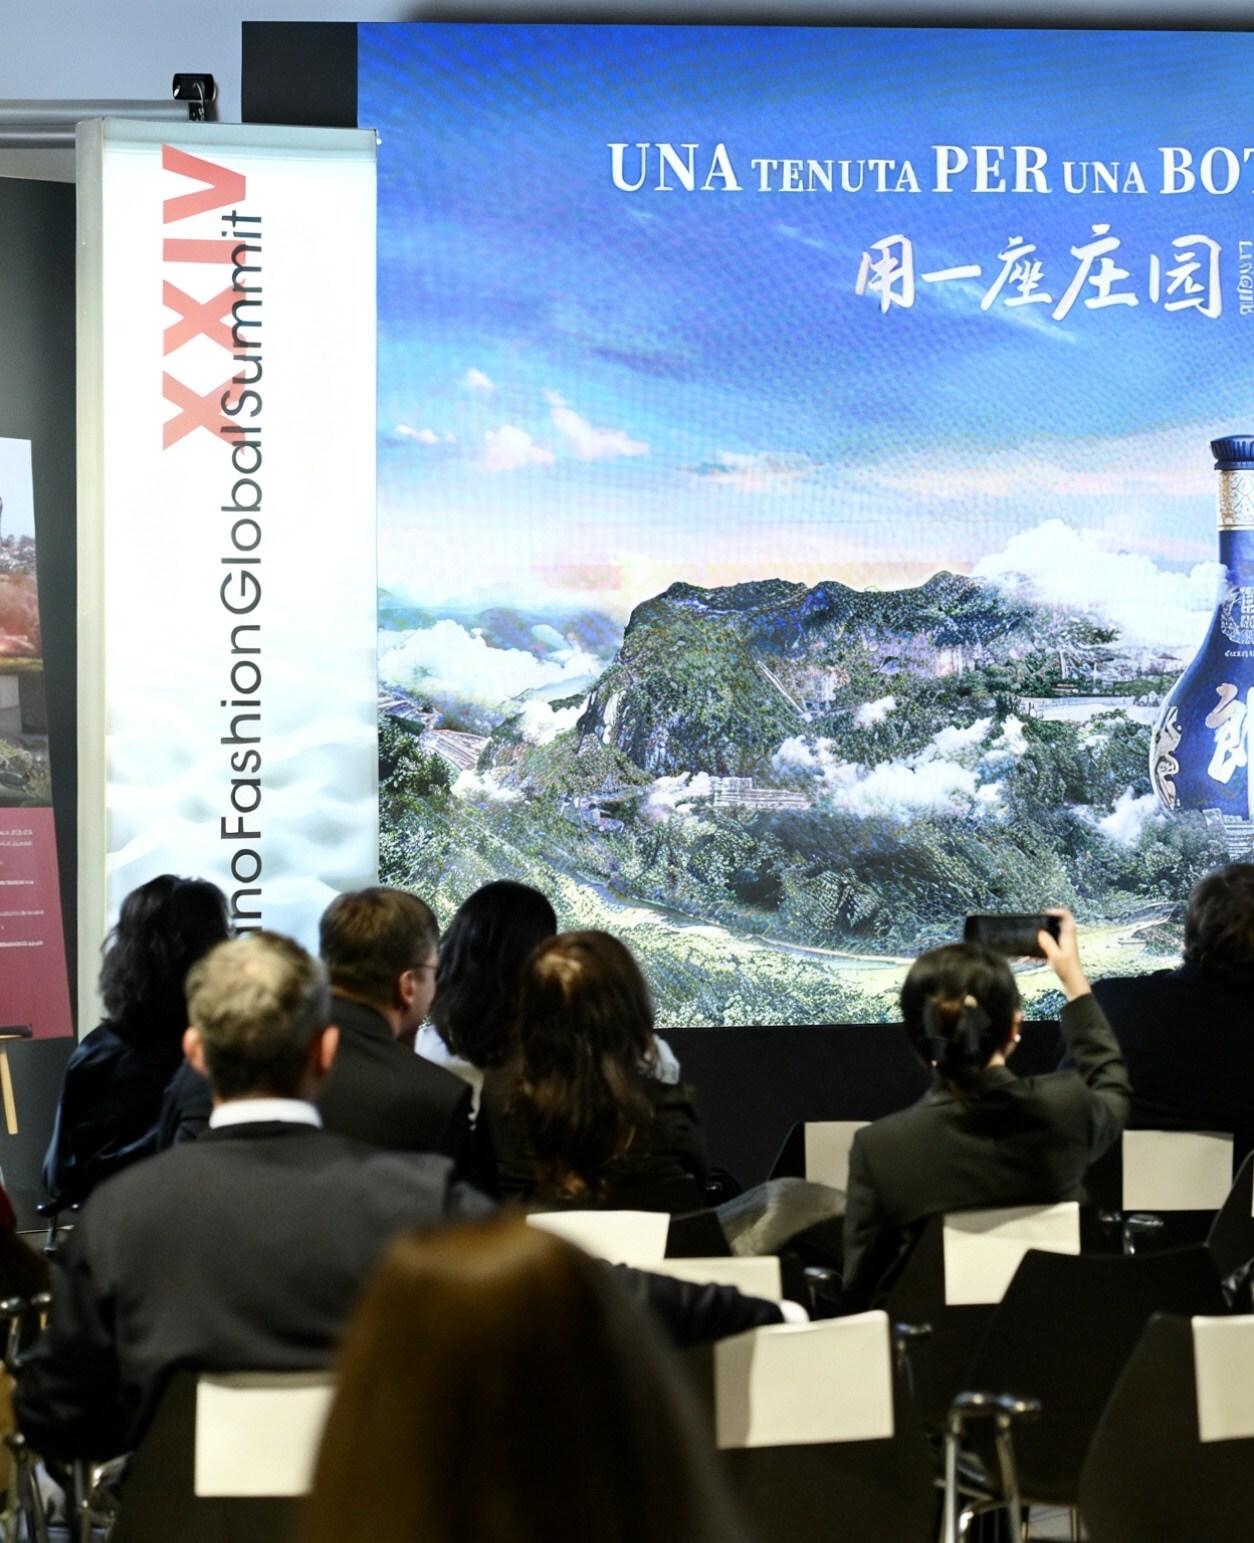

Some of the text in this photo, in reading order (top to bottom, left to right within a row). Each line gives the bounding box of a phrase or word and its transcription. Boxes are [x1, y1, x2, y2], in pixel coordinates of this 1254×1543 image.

[607, 142, 743, 193] UNA
[750, 158, 921, 194] TENUTA
[931, 144, 1051, 195] PER
[1061, 160, 1149, 195] UNA
[161, 142, 247, 455] XXIV
[854, 222, 1223, 321] 用一座庄园
